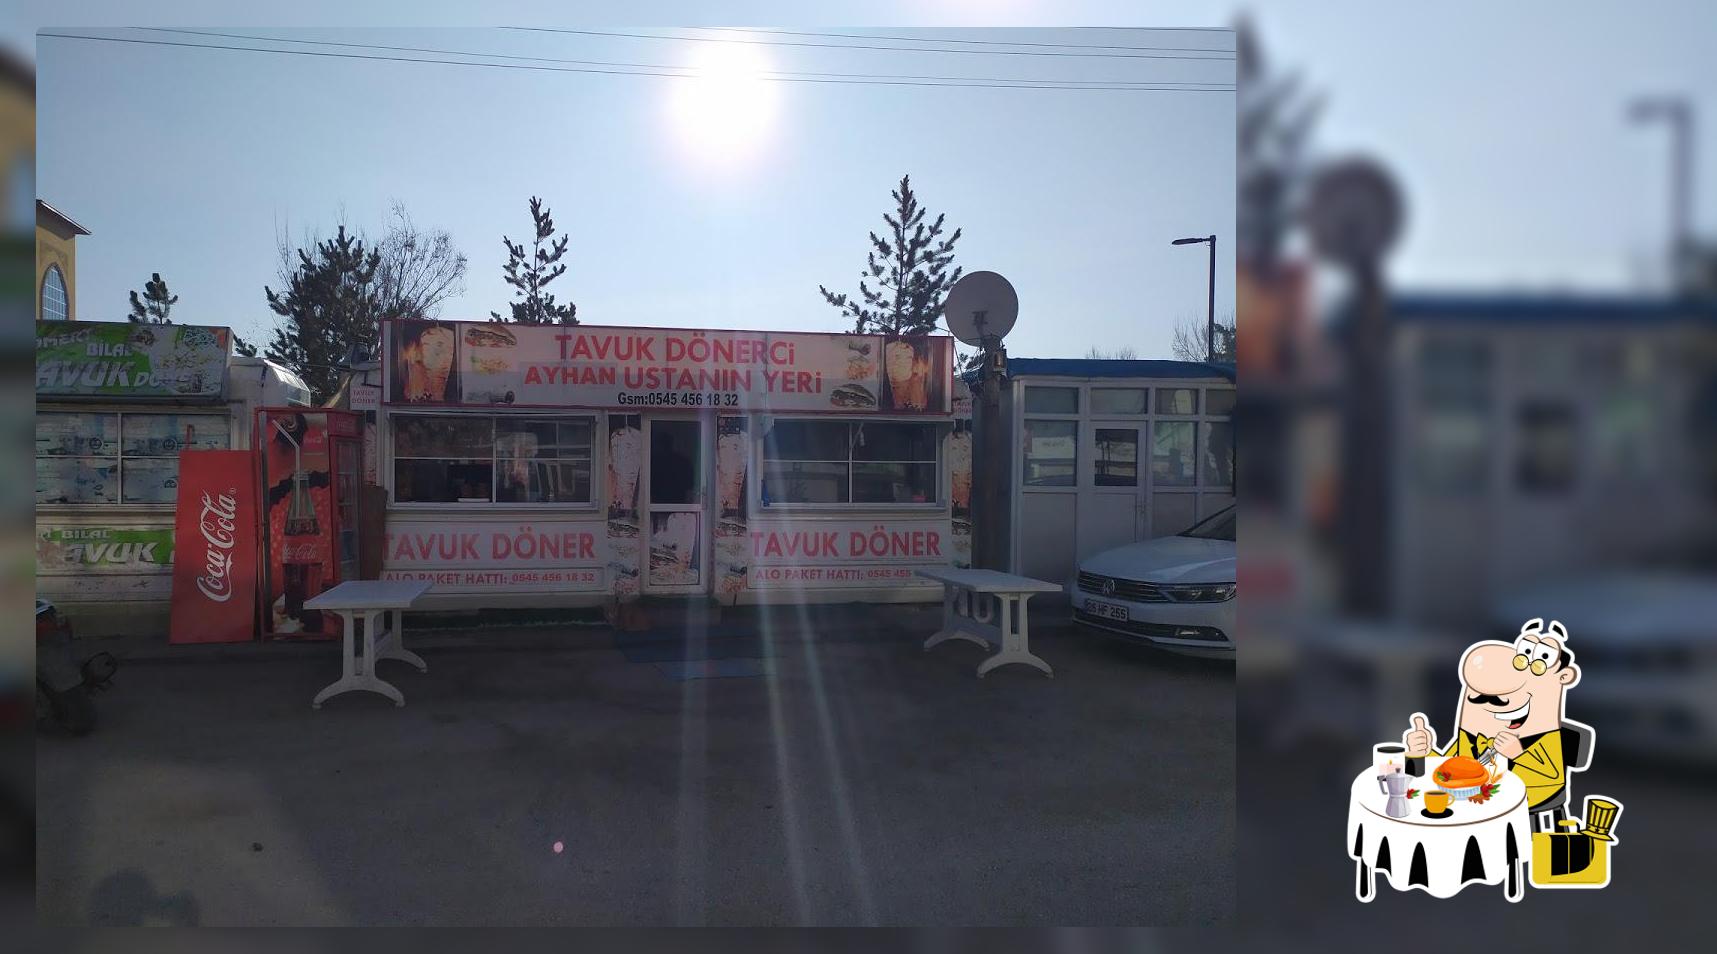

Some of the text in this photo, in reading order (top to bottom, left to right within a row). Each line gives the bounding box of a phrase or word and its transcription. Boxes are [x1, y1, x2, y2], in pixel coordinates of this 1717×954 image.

[555, 335, 656, 361] TAVUK
[524, 366, 615, 385] AYHAN
[624, 367, 751, 391] USTANIN
[681, 393, 702, 406] 456
[706, 393, 720, 406] 18
[724, 393, 738, 406] 32
[196, 488, 236, 602] Coca-Cola
[491, 526, 594, 559] DÖNER
[750, 525, 941, 557] TAVUK DÖNER
[511, 573, 538, 582] 0545
[542, 573, 561, 582] 456
[580, 572, 594, 582] 32
[755, 569, 780, 580] ALO
[784, 569, 822, 580] PAKET
